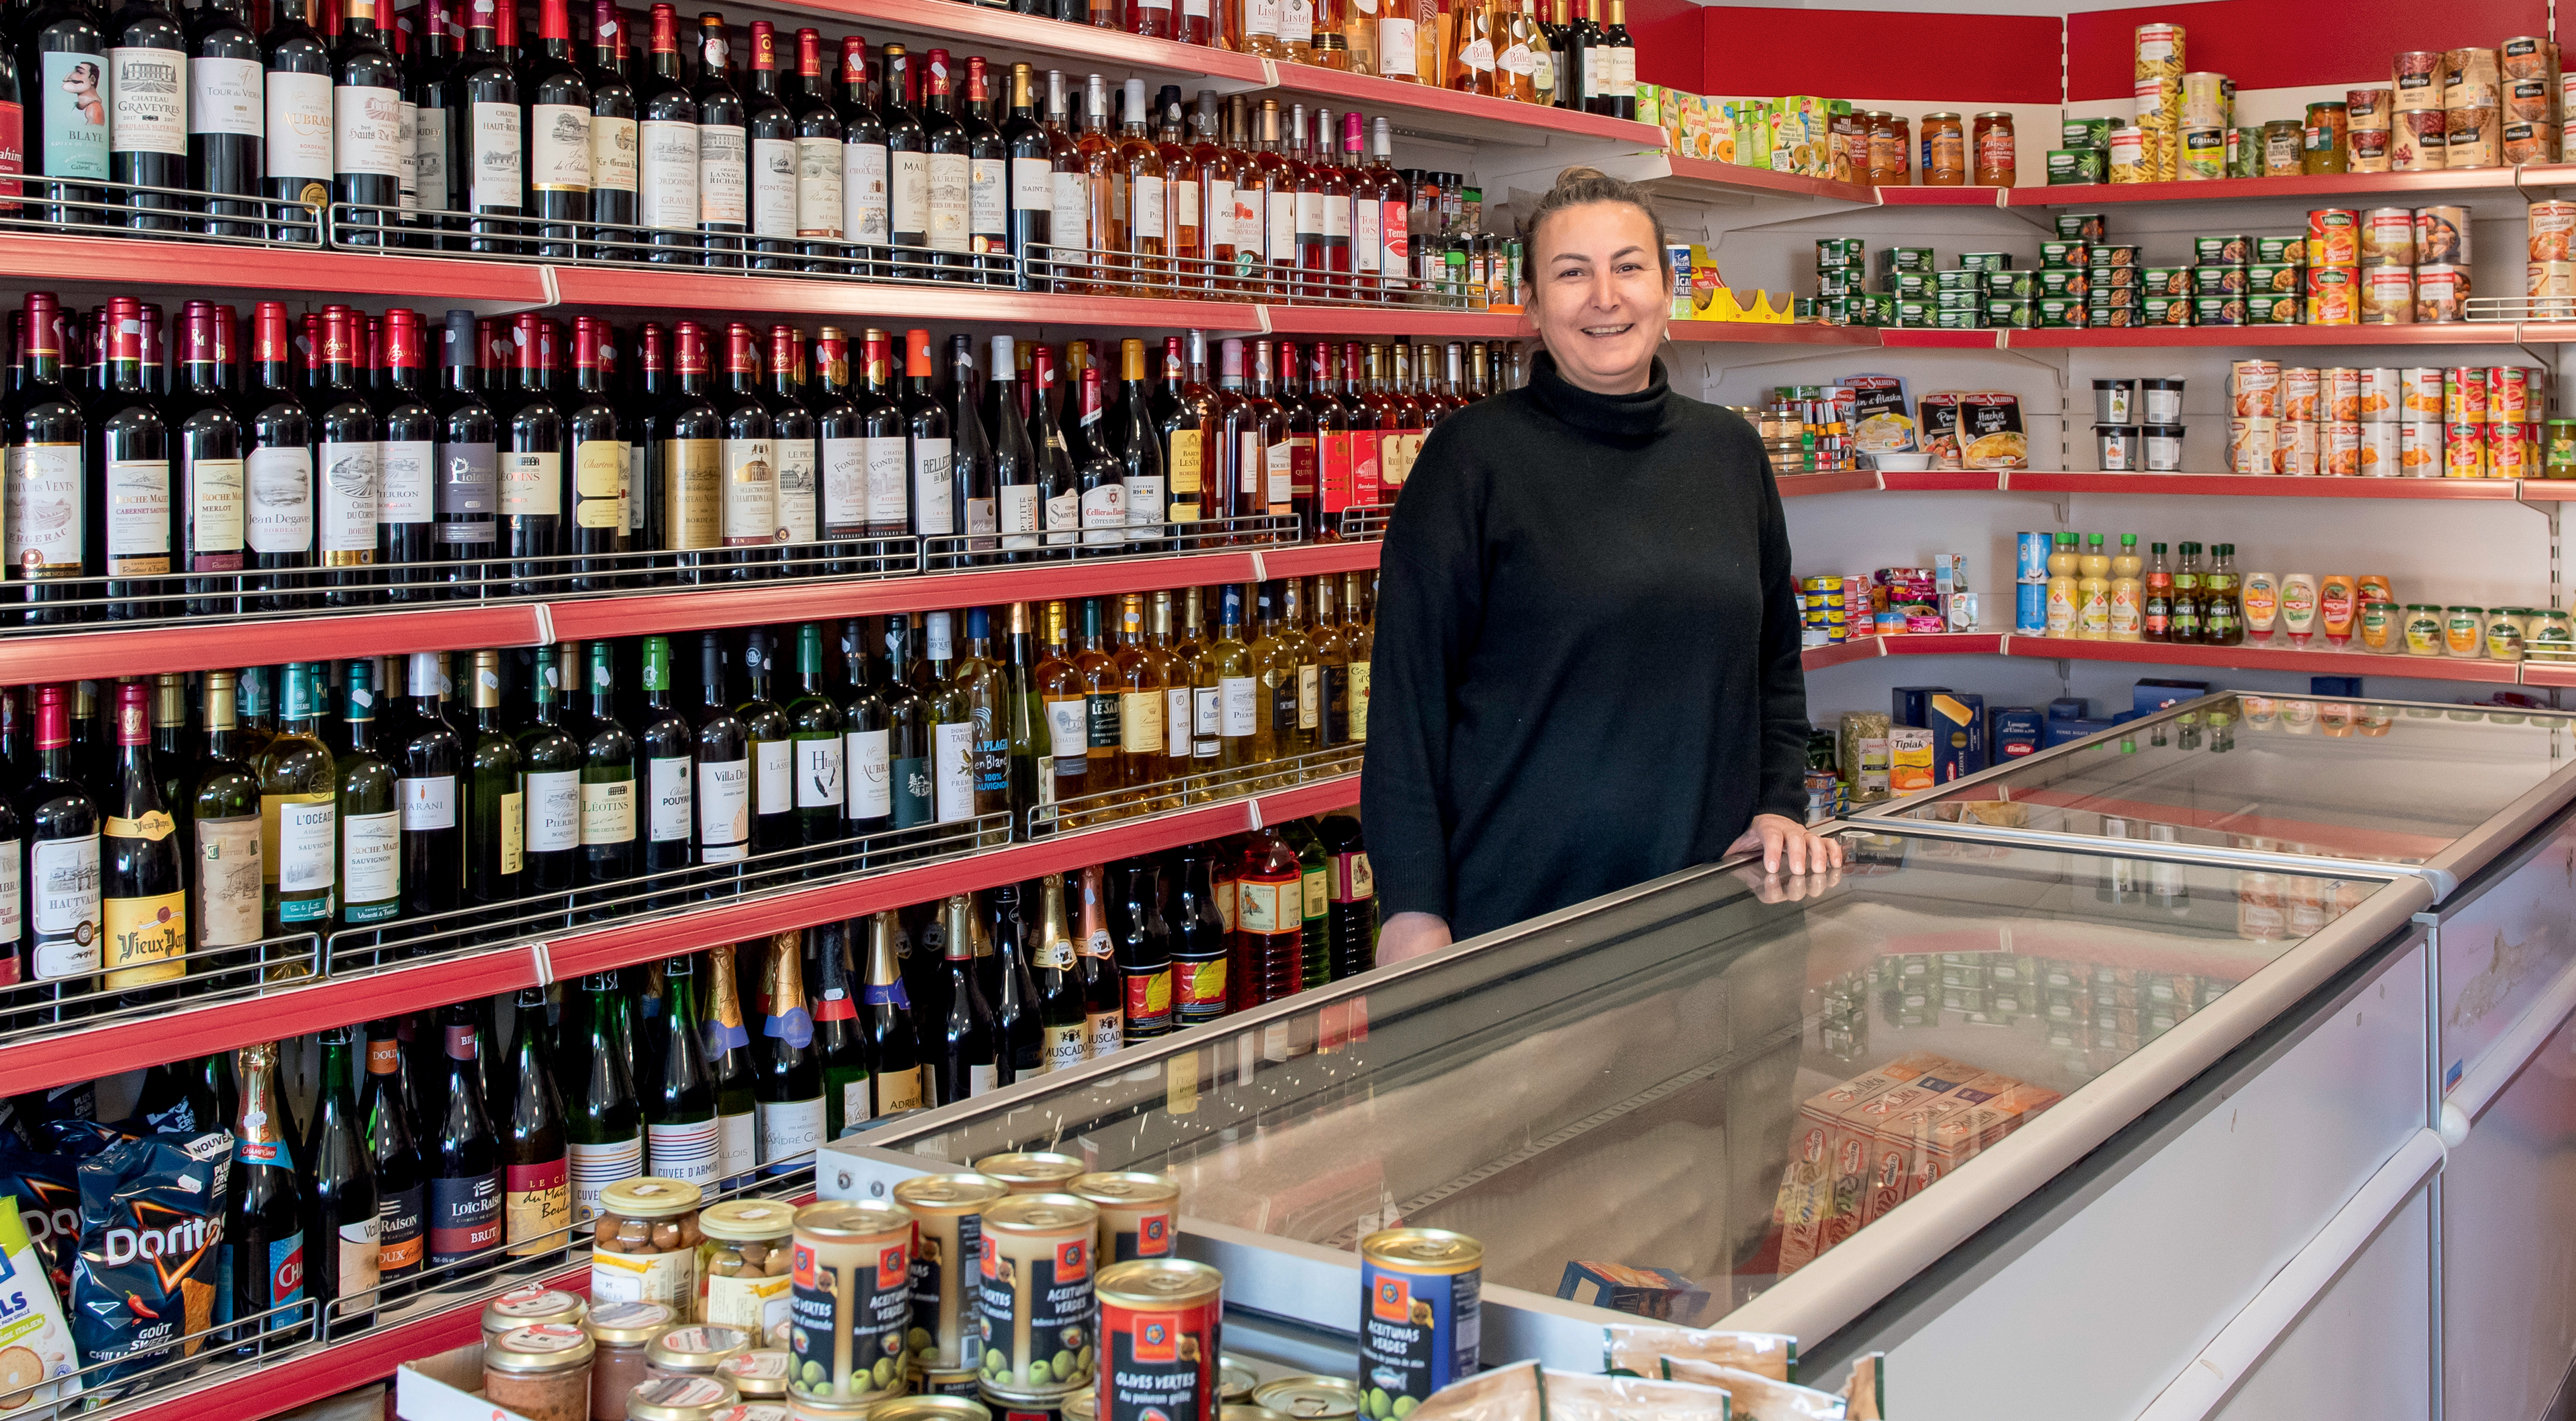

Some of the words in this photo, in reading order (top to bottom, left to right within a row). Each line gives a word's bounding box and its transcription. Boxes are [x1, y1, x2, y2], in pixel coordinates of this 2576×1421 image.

[1282, 10, 1309, 25] Listel
[207, 87, 232, 96] TOUR
[118, 101, 180, 116] GRAVEYRES
[282, 111, 333, 131] AUBRAD
[69, 130, 104, 143] BLAYE
[2190, 136, 2221, 145] d'aucy
[2324, 216, 2351, 225] PANZANI
[1845, 378, 1867, 387] William
[1867, 376, 1897, 389] SAURIN
[1966, 395, 1987, 404] William
[1987, 392, 2014, 406] SAURIN
[1977, 410, 2005, 421] Hachis
[835, 459, 856, 473] FOND
[870, 457, 893, 471] FOND
[46, 480, 74, 492] VENTS
[116, 494, 148, 504] ROCHE
[202, 493, 231, 502] ROCHE
[347, 511, 357, 519] DU
[1086, 507, 1106, 516] Cellier
[248, 513, 272, 525] Jean
[276, 513, 310, 526] Degaves
[2147, 606, 2167, 615] PUGET
[1092, 703, 1102, 715] LE
[983, 739, 1008, 752] PLAGE
[1895, 740, 1924, 751] Tipiak
[2006, 744, 2034, 754] Barilla
[974, 761, 985, 770] en
[986, 754, 1008, 770] Blanc
[714, 770, 735, 782] Villa
[984, 772, 1002, 781] 100%
[401, 801, 444, 811] TARANI
[582, 799, 629, 812] LÉOTINS
[134, 820, 155, 834] Vieux
[353, 844, 381, 855] ROCHE
[351, 855, 391, 865] SAUVIGNON
[118, 929, 165, 963] Vieux
[890, 1096, 920, 1110] ADRIEN
[764, 1133, 802, 1146] ANDRÉ
[241, 1146, 276, 1159] CHAMPOMY
[658, 1167, 685, 1179] CUVÉE
[529, 1178, 546, 1189] LE
[523, 1192, 540, 1204] du
[452, 1202, 480, 1217] LOÏC
[380, 1214, 418, 1233] RAISON
[470, 1226, 497, 1244] BRUT
[138, 1322, 173, 1340] GOÛT
[1367, 1318, 1420, 1343] ACEITUNAS
[1372, 1335, 1408, 1355] VERDES
[1115, 1371, 1153, 1390] OLIVES
[1155, 1371, 1196, 1390] VERTES
[1119, 1389, 1132, 1403] Au
